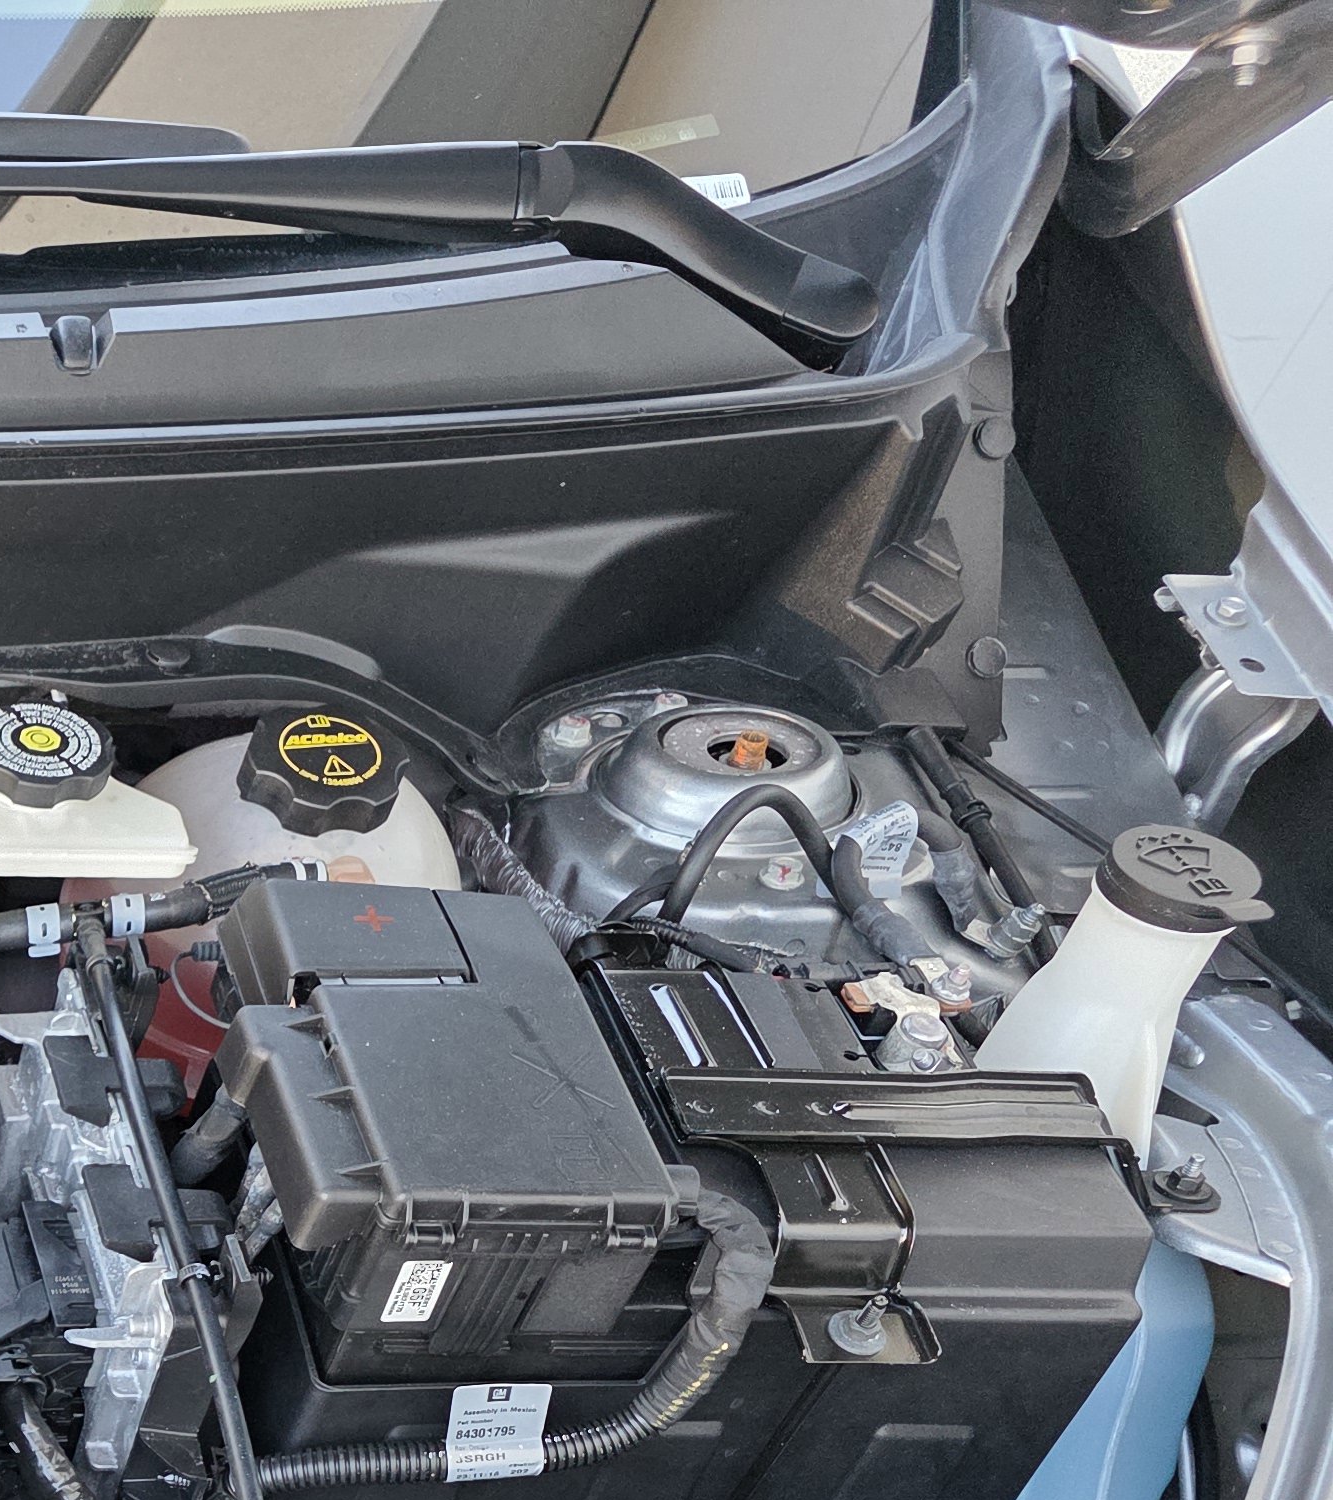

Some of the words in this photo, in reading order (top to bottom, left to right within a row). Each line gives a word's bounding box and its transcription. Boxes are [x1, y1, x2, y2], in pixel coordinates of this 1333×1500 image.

[285, 732, 369, 747] ACDelco
[463, 1407, 498, 1416] Assembly
[455, 1425, 517, 1440] 84301795
[455, 1452, 506, 1464] JSRGH
